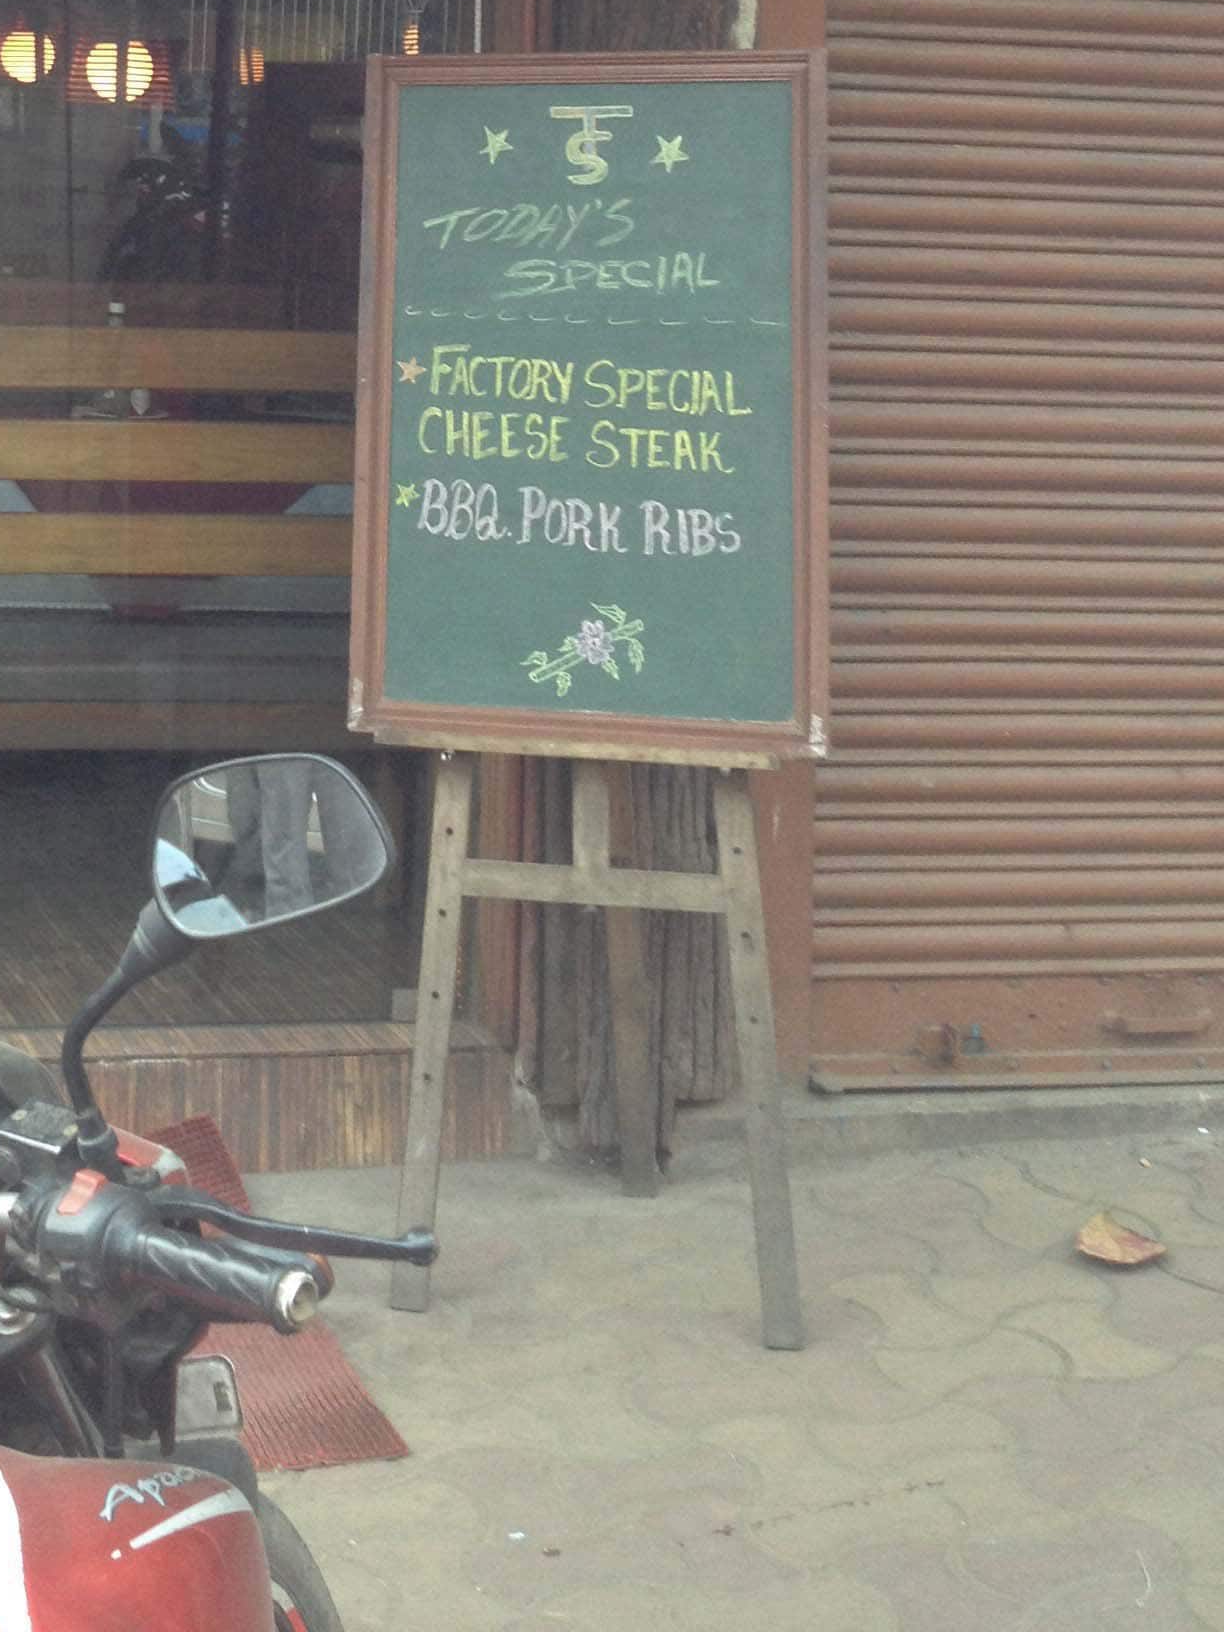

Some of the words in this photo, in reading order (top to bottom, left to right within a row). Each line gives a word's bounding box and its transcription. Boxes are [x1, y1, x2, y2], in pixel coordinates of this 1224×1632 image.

[497, 252, 720, 300] SPECIAL
[427, 344, 574, 405] FACTORY
[583, 359, 753, 416] SPECIAL
[418, 406, 570, 463] CHEESE
[585, 419, 736, 475] STEAK
[516, 485, 628, 554] PORK
[639, 498, 742, 557] RIBS
